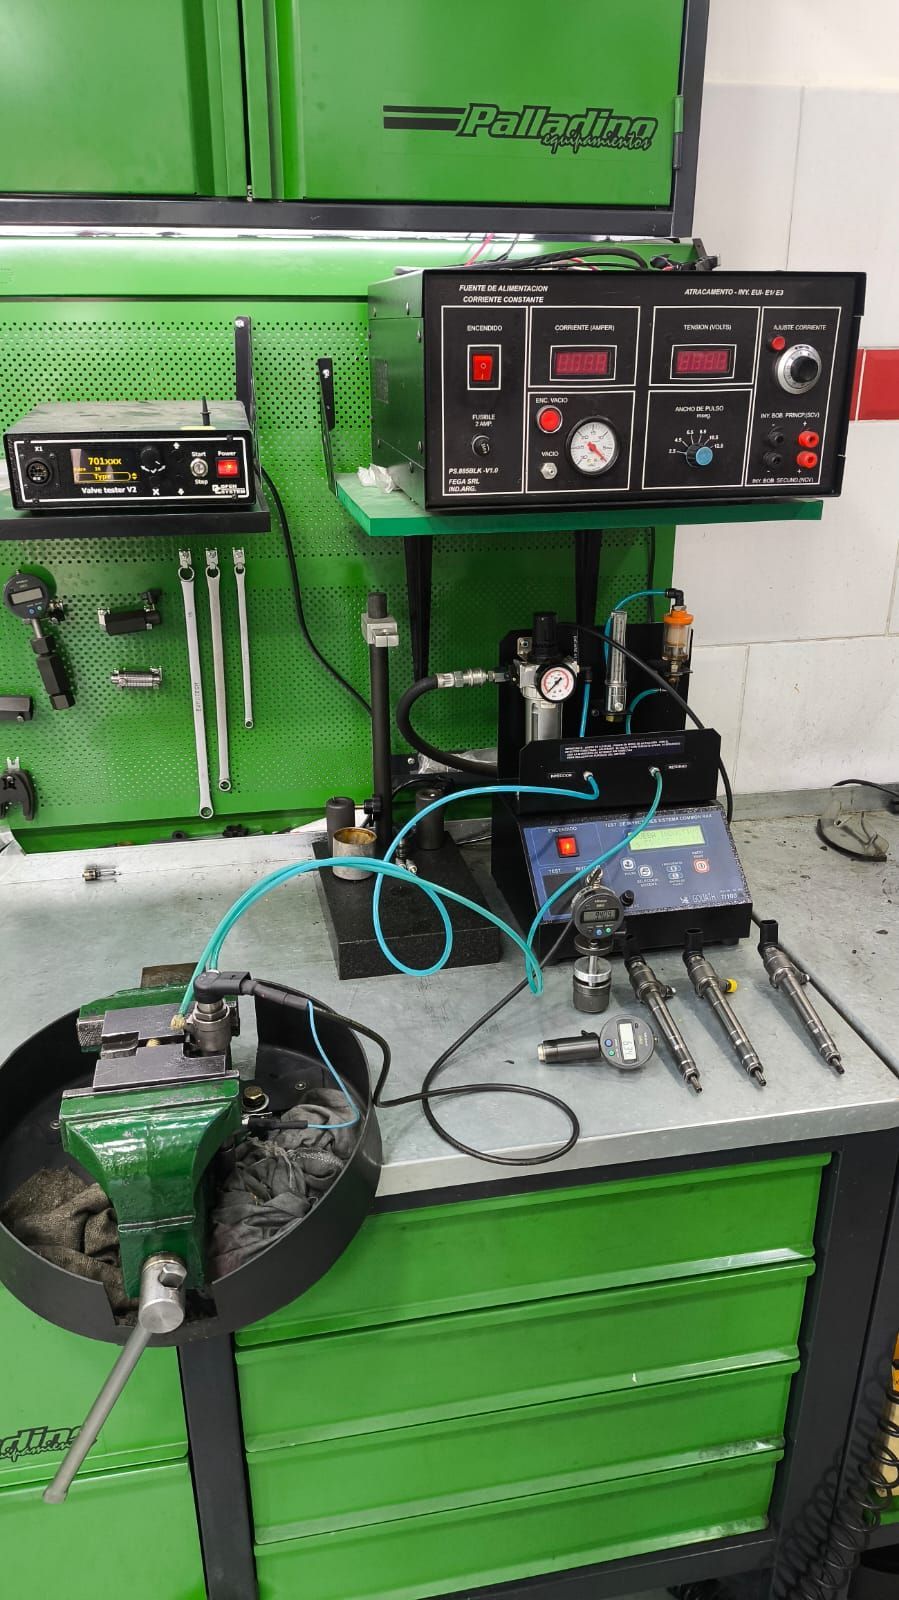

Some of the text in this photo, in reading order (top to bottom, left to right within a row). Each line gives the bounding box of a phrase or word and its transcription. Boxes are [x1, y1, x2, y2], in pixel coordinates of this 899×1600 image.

[455, 103, 658, 141] Palladino
[541, 131, 653, 154] equipamientos
[459, 284, 549, 292] FUENTE DE ALIMENTACION
[684, 288, 733, 296] ATRACAMENTO
[463, 295, 545, 303] CORRIENTE CONSTANTE
[448, 478, 466, 486] FEGA
